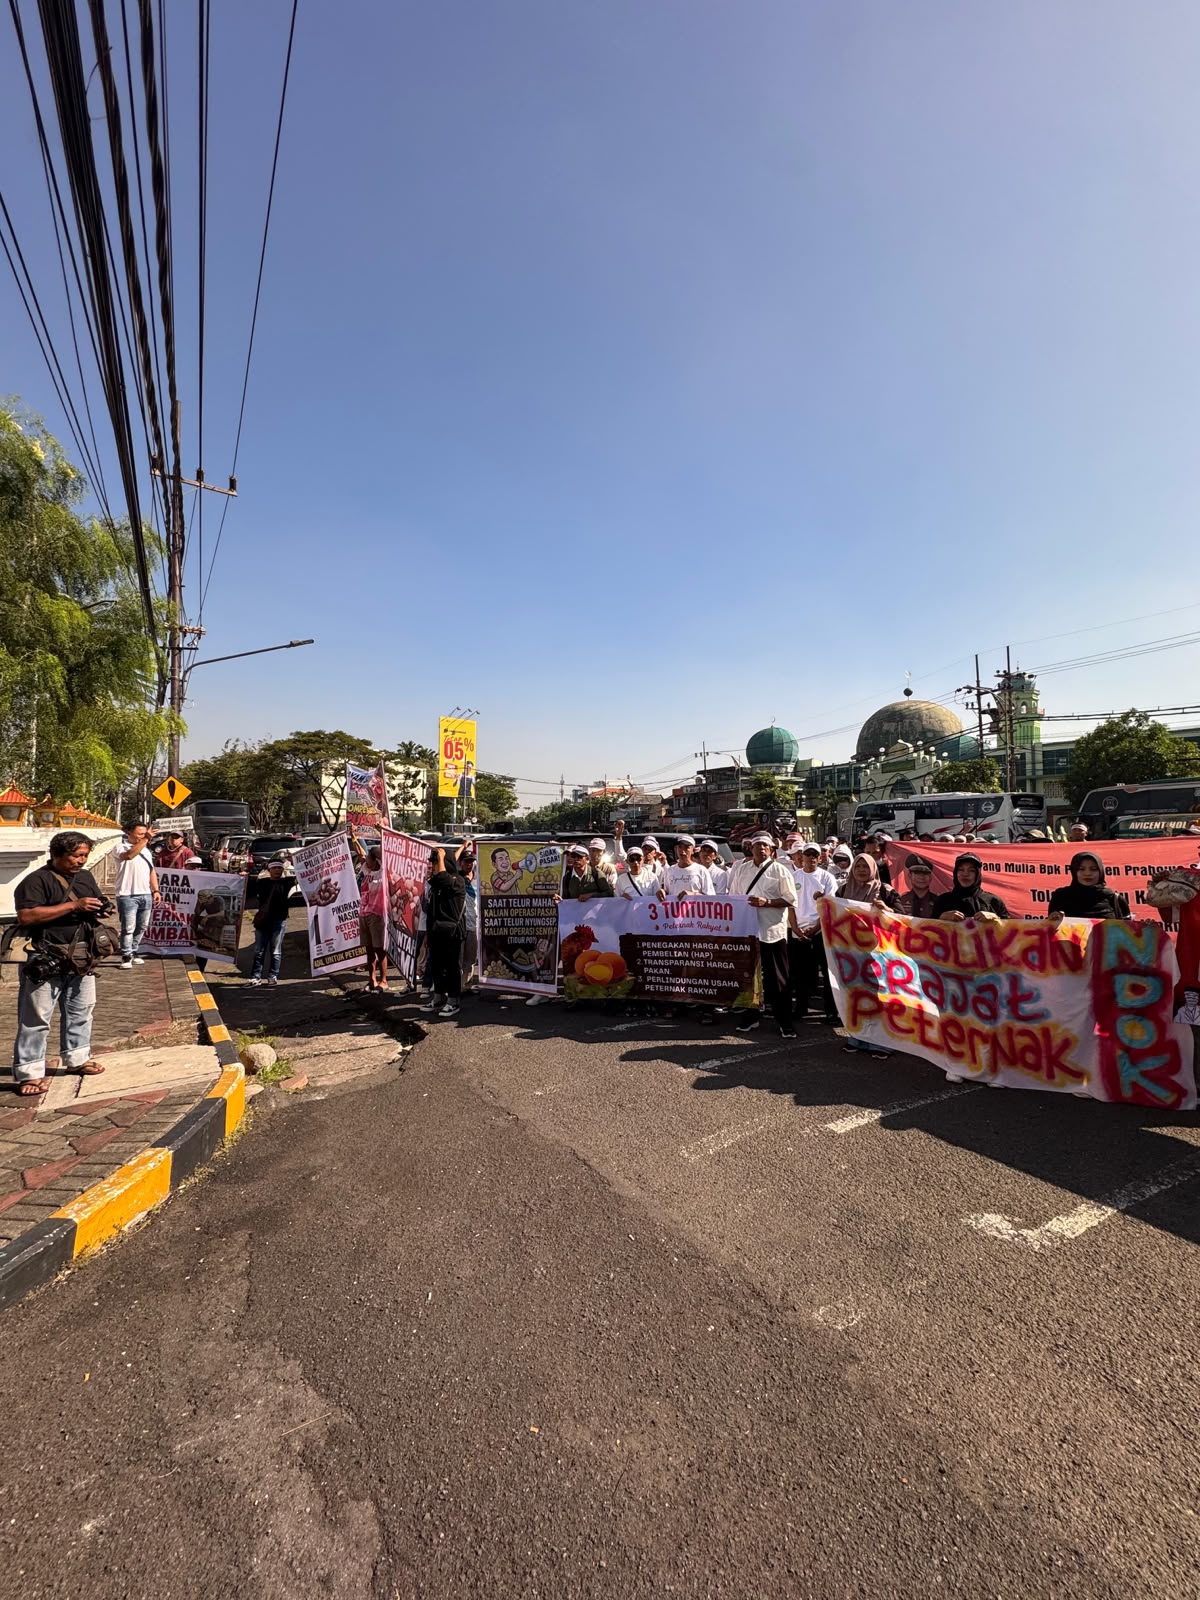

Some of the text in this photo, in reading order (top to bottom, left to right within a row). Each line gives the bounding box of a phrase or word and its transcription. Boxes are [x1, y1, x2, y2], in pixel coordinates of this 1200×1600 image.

[1129, 821, 1167, 830] AVICENT
[296, 836, 344, 863] NEGARA JANGAN
[383, 836, 406, 855] HARGA
[304, 848, 340, 869] PILIH KASIH!
[539, 849, 556, 858] SIDAK
[333, 854, 349, 865] PASAR
[540, 855, 560, 866] PASAR!
[1004, 863, 1035, 874] Mulia
[1039, 864, 1061, 875] Bpk
[1031, 889, 1052, 903] Tol
[488, 899, 508, 908] SAAT
[509, 898, 530, 907] TELUR
[338, 910, 360, 923] NASIB
[484, 909, 509, 917] KALIAN
[510, 908, 536, 917] OPERASI
[648, 901, 733, 921] 3 TUNTUTAN
[336, 920, 360, 933] PETERN
[484, 918, 503, 927] SAAT
[504, 918, 524, 926] TELUR
[663, 921, 722, 932] Peternak Rakyat
[484, 928, 557, 936] KALIAN OPERASI SENYAP
[721, 944, 751, 952] ACUAN
[325, 953, 345, 965] UNTUK
[691, 951, 714, 960] (HAP)
[706, 961, 735, 969] HARGA
[644, 967, 673, 975] PAKAN.
[646, 976, 709, 986] PERLINDUNGAN
[711, 980, 740, 988] USAHA
[645, 984, 718, 995] PETERNAK RAKYAT
